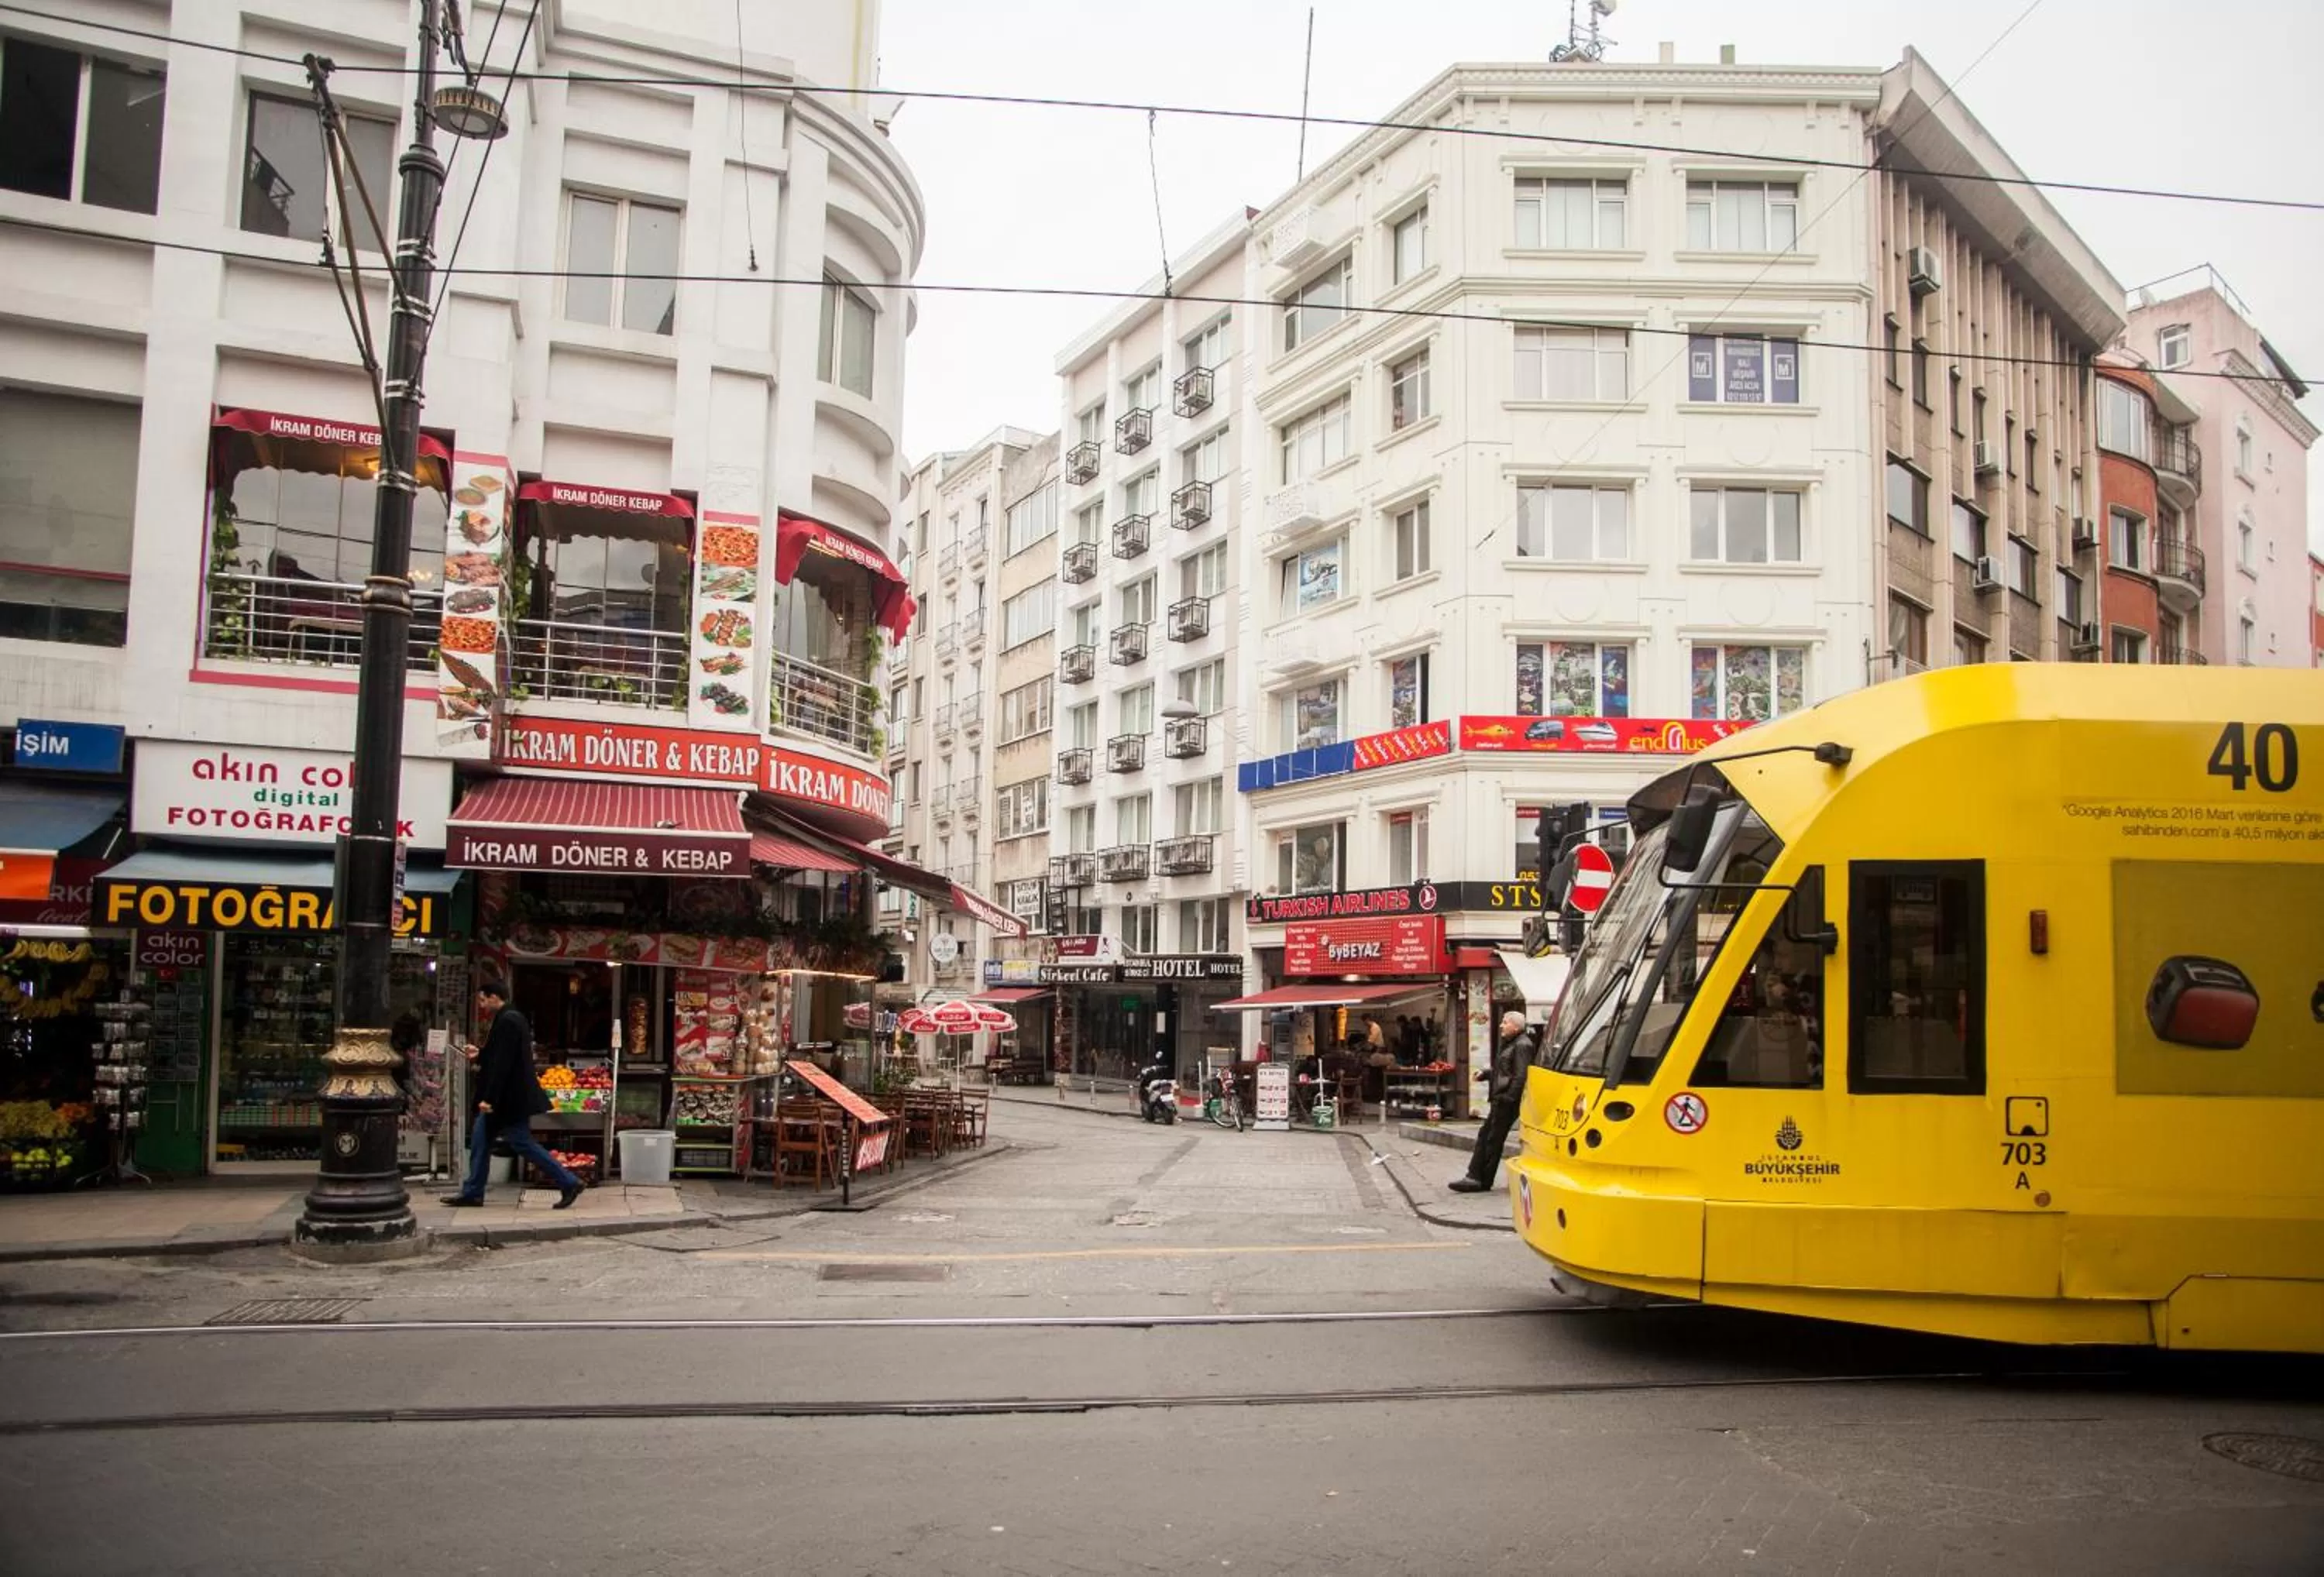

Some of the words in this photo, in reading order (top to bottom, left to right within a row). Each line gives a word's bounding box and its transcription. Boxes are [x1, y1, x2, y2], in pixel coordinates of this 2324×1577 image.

[270, 417, 310, 435] İKRAM
[314, 424, 356, 442] DÖNER
[359, 432, 382, 445] KEB
[590, 491, 627, 507] DÖNER
[629, 496, 662, 510] KEBAP
[585, 728, 658, 769] DÖNER
[665, 742, 682, 771] &
[689, 743, 759, 775] KEBAP
[2208, 721, 2298, 792] 40
[192, 752, 277, 783] akın
[301, 761, 355, 788] col
[768, 751, 846, 805] İKRAM
[254, 788, 339, 807] digital
[168, 806, 415, 837] FOTOĞRAFCK
[2171, 807, 2203, 819] 2016
[2207, 808, 2235, 820] Mart
[464, 837, 538, 864] İKRAM
[552, 840, 628, 867] DÖNER
[634, 848, 649, 868] &
[662, 849, 732, 871] KEBAP
[107, 885, 431, 936] FOTOĞRÇI
[1262, 895, 1329, 919] TURKISH
[1331, 888, 1410, 914] AIRLINES
[140, 949, 205, 964] color
[1082, 967, 1110, 981] Cafe
[1153, 960, 1205, 977] HOTEL
[1211, 964, 1241, 974] HOTEL
[2000, 1142, 2046, 1165] 703
[1745, 1161, 1841, 1177] BÜYÜKŞEHİR
[2015, 1171, 2030, 1190] A
